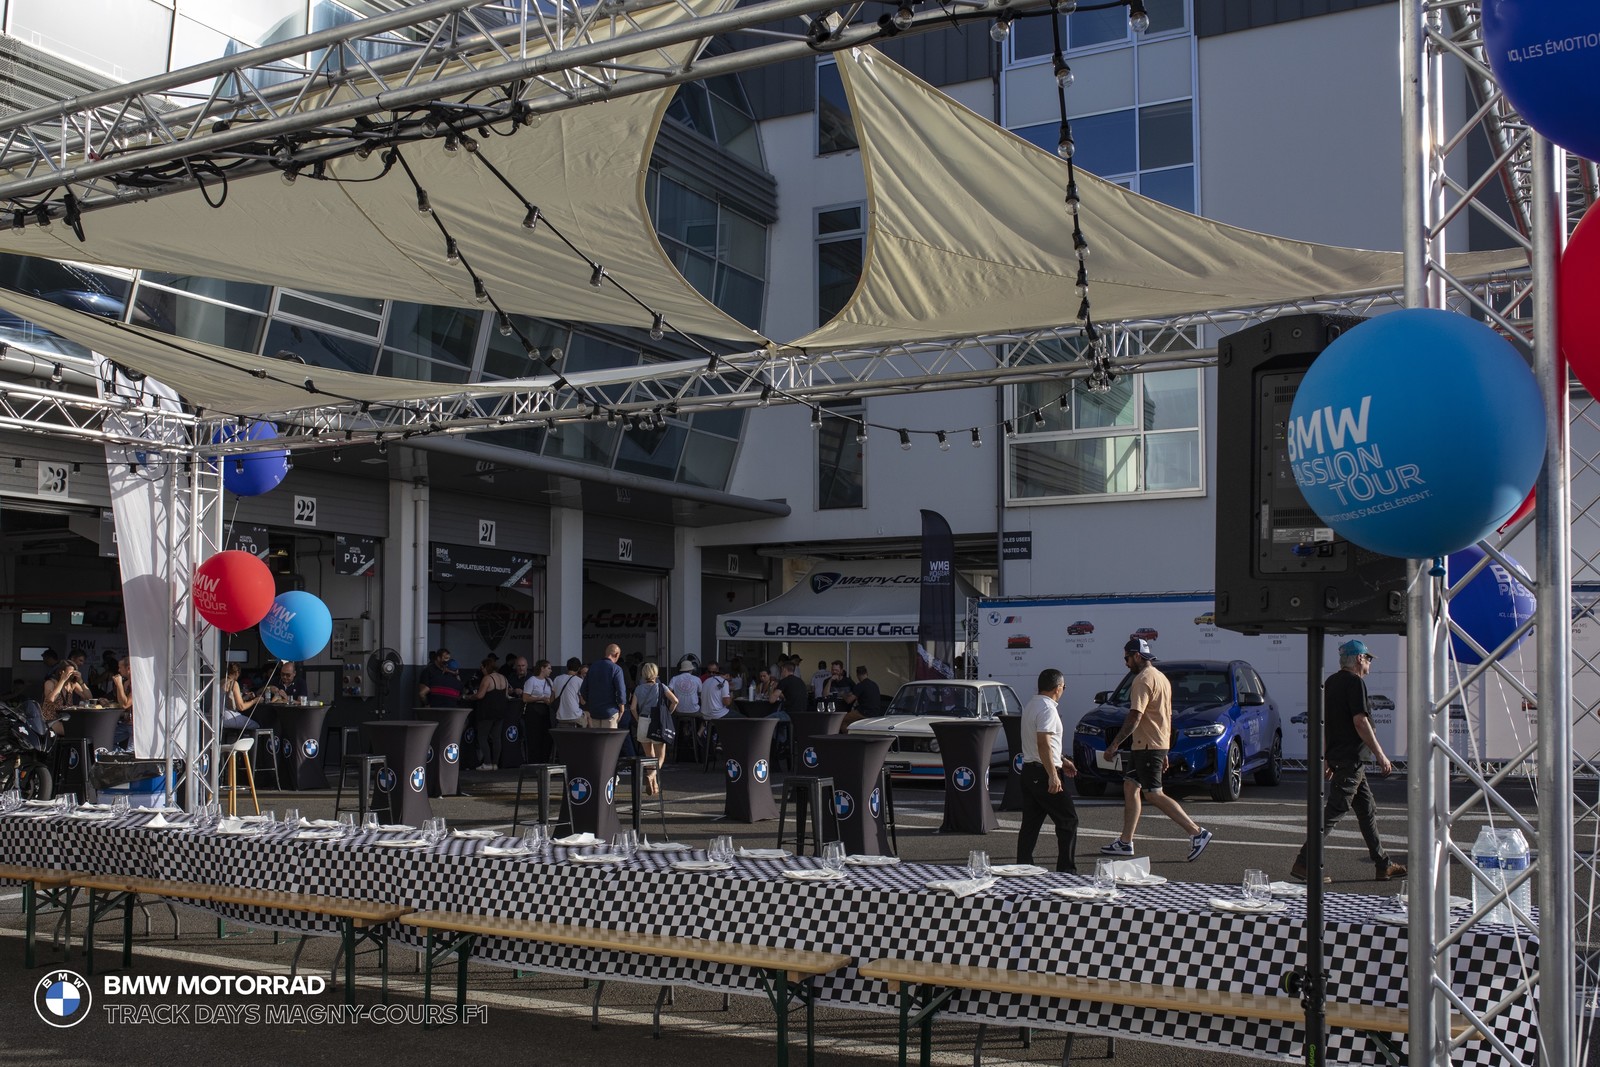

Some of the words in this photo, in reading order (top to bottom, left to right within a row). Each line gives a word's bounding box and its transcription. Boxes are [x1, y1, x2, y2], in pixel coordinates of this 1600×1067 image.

[1522, 44, 1543, 59] LES
[1545, 32, 1600, 55] ÉMOTIO
[1288, 395, 1372, 462] BMW
[38, 466, 67, 493] 23
[1328, 463, 1426, 506] TOUR
[295, 499, 315, 522] 22
[480, 523, 493, 542] 21
[344, 553, 350, 562] P
[352, 554, 358, 563] à
[360, 554, 366, 564] Z
[620, 540, 631, 559] 20
[456, 562, 485, 572] SIMULATEURS
[491, 566, 511, 574] CONDUITE
[728, 556, 738, 571] 19
[838, 575, 921, 586] Magny-Cou
[199, 598, 227, 611] TOUR
[270, 602, 297, 623] MW
[269, 624, 295, 641] TOUR
[71, 639, 96, 650] BMW
